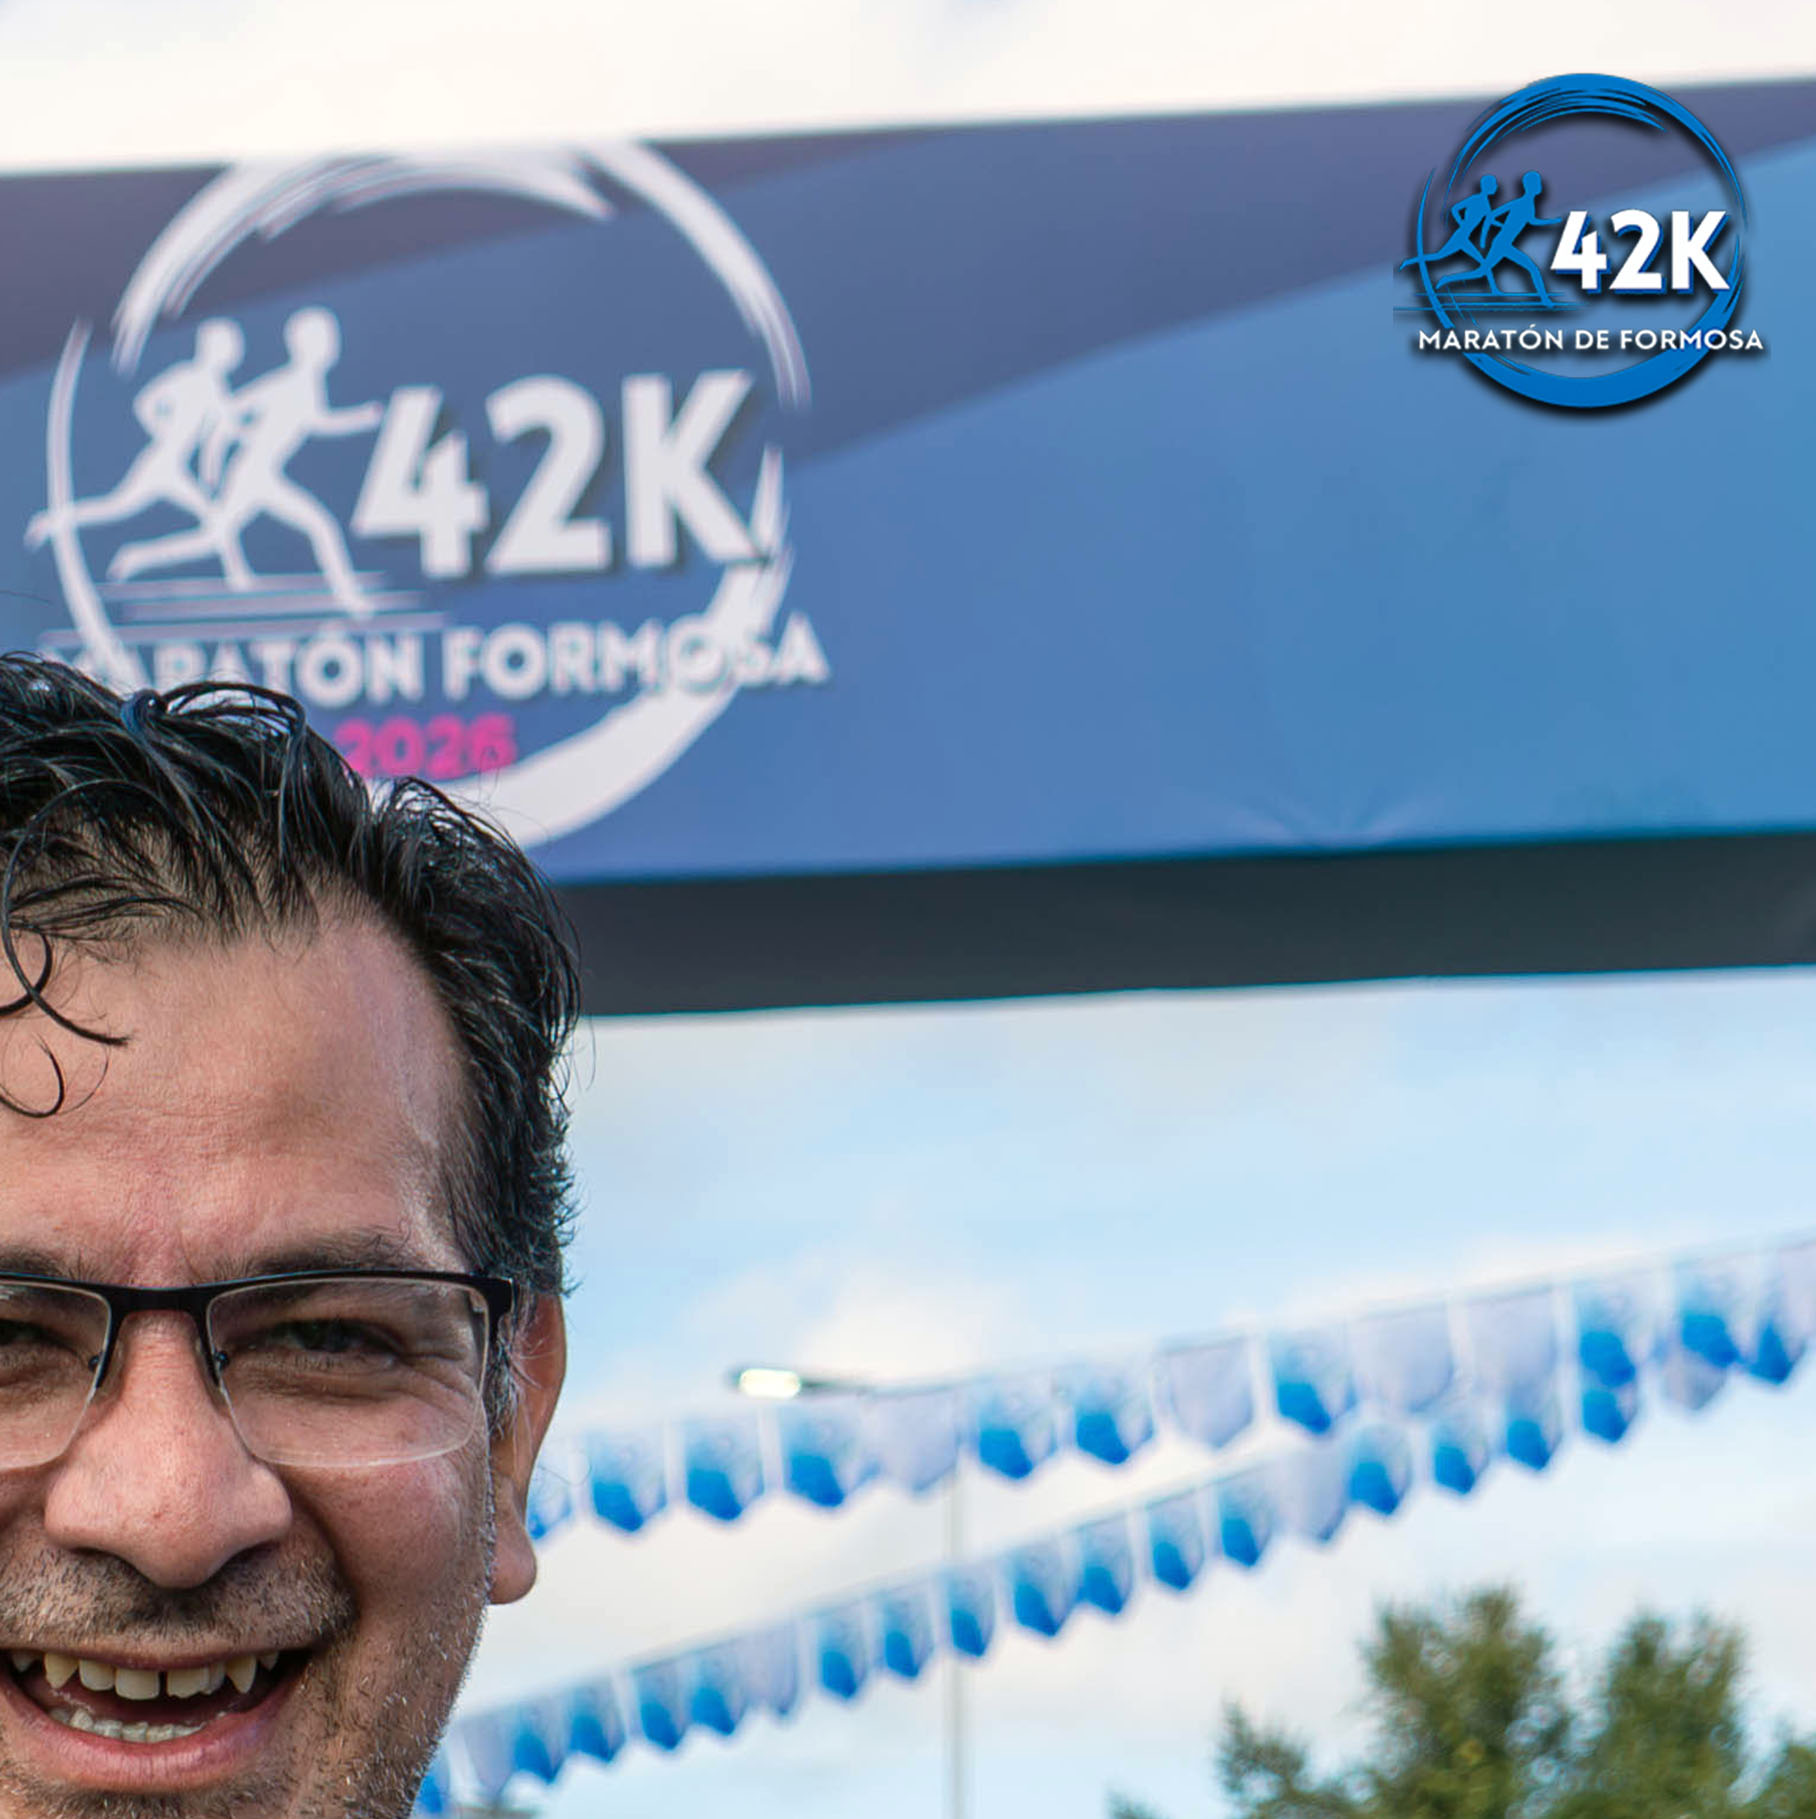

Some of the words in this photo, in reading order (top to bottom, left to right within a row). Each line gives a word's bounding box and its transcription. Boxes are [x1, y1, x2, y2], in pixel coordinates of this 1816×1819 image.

[350, 367, 768, 578] 42K
[48, 622, 424, 706] ARATÓN
[441, 612, 830, 703] FORMOSA
[336, 713, 518, 781] 2026
